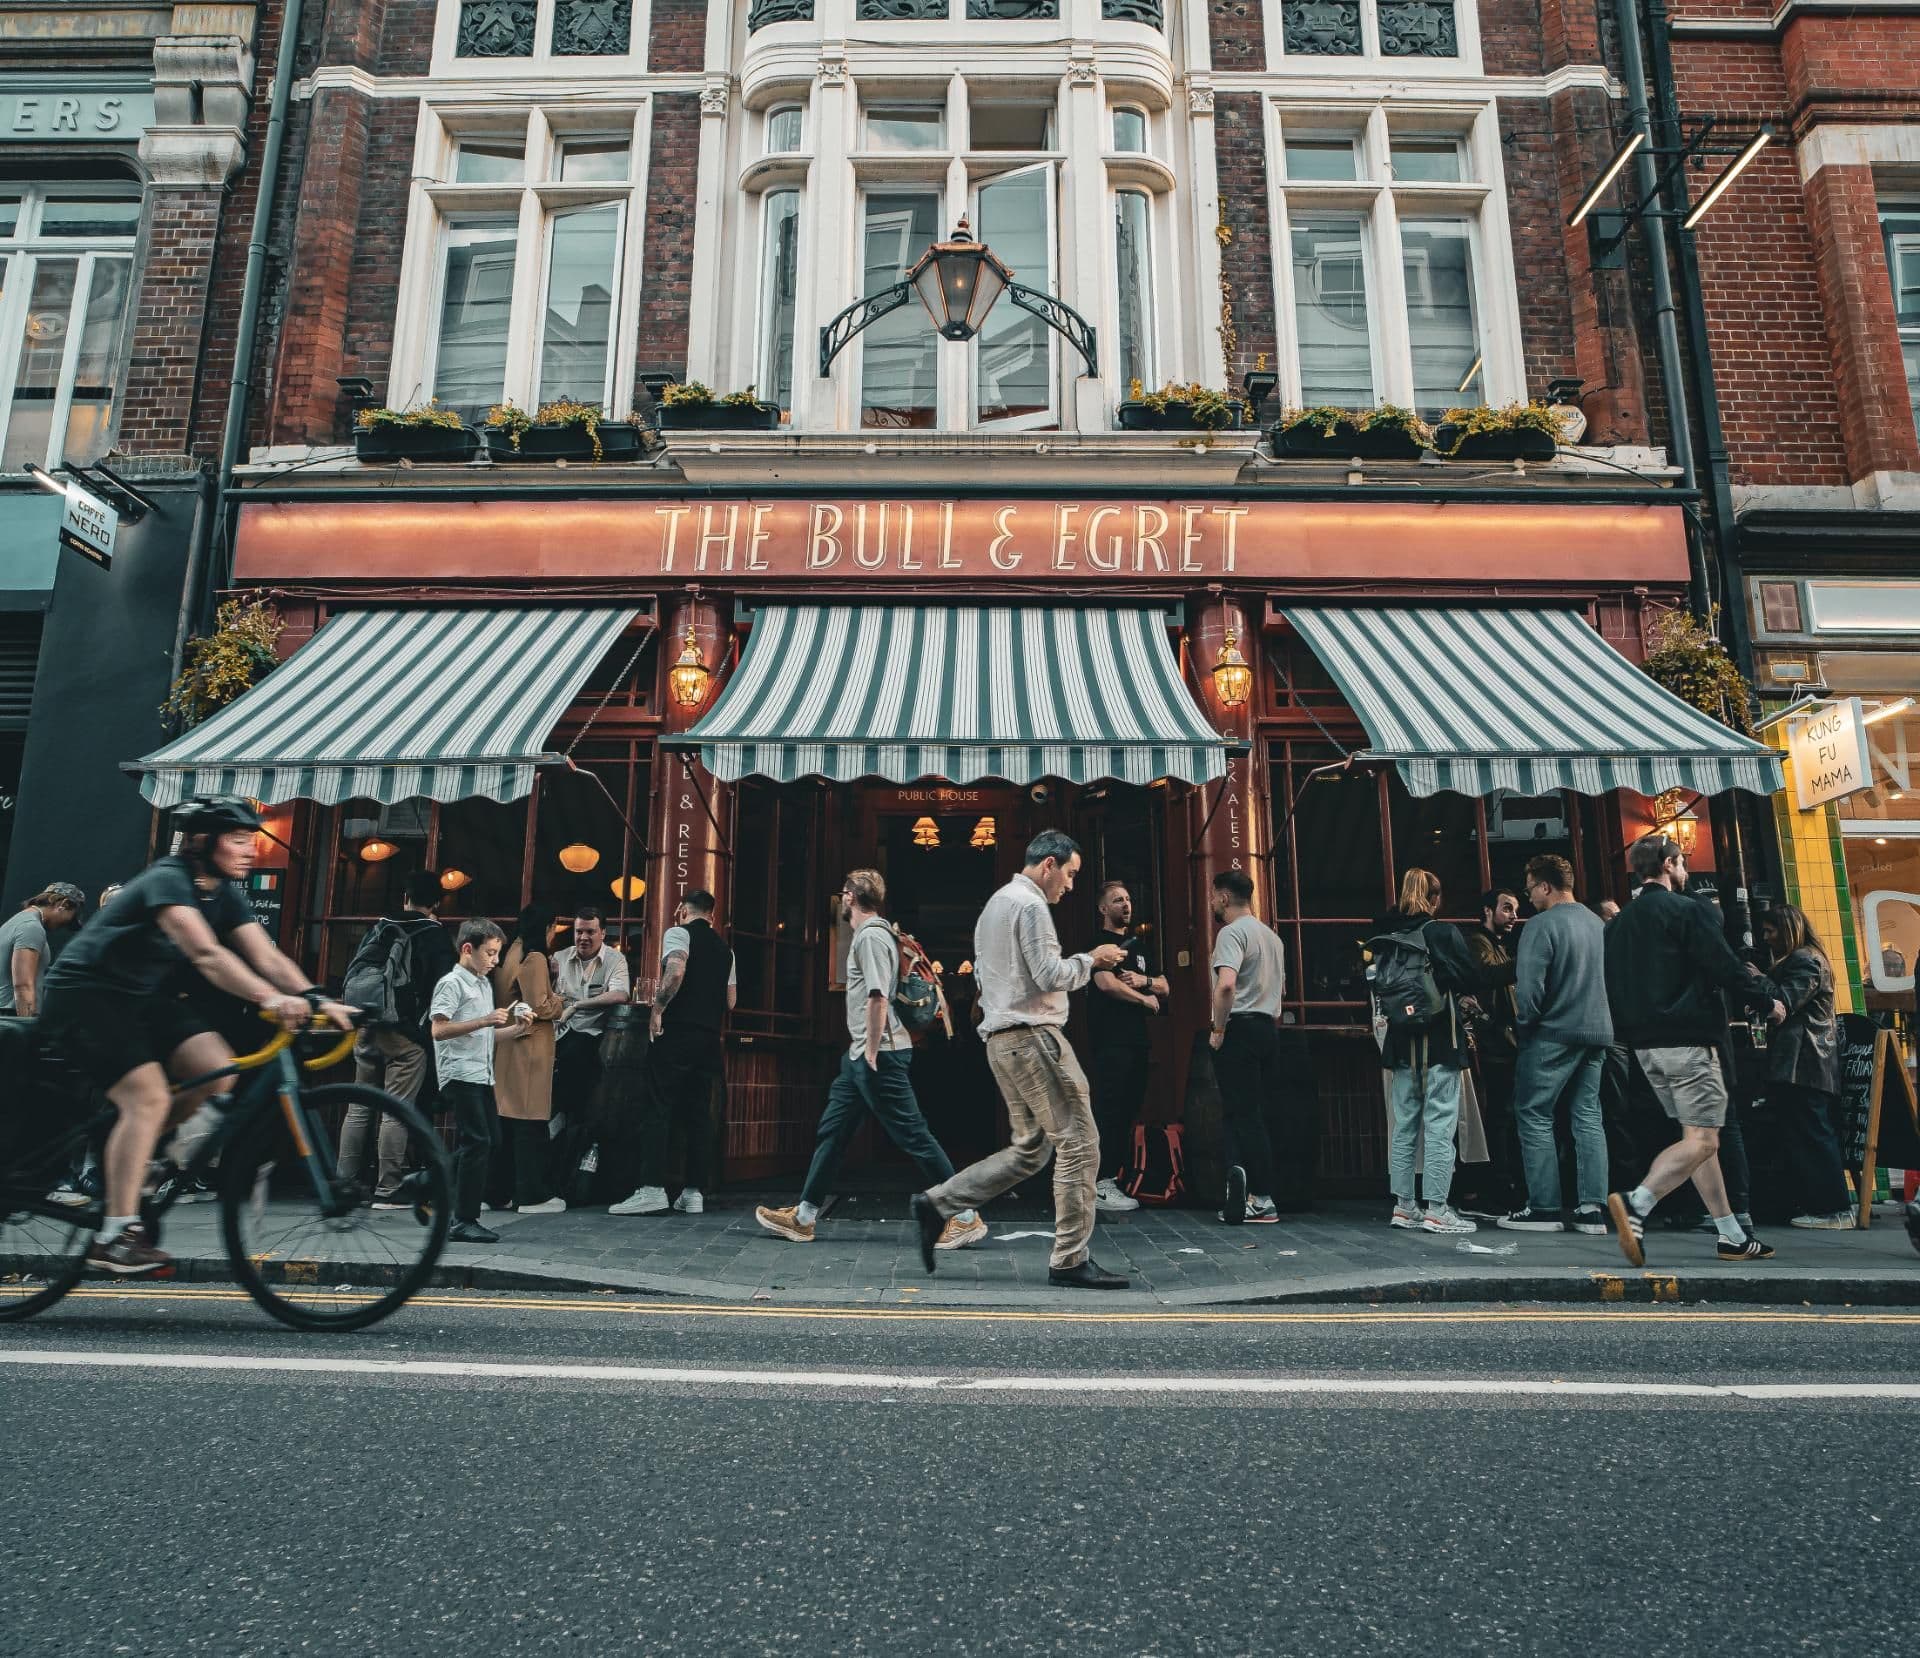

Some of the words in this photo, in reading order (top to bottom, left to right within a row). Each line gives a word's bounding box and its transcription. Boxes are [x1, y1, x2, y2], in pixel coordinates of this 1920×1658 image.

[69, 509, 110, 546] NERO
[654, 503, 774, 571] THE
[806, 502, 963, 570] BULL
[989, 504, 1023, 570] &
[1051, 503, 1249, 572] EGRET
[1807, 714, 1841, 743] KUNG
[1819, 743, 1837, 765] FU
[1811, 764, 1853, 795] MAMA
[679, 794, 694, 809] &
[898, 790, 937, 801] PUBLIC
[940, 790, 979, 801] HOUSE
[1227, 793, 1240, 848] ALES
[1231, 857, 1242, 870] &
